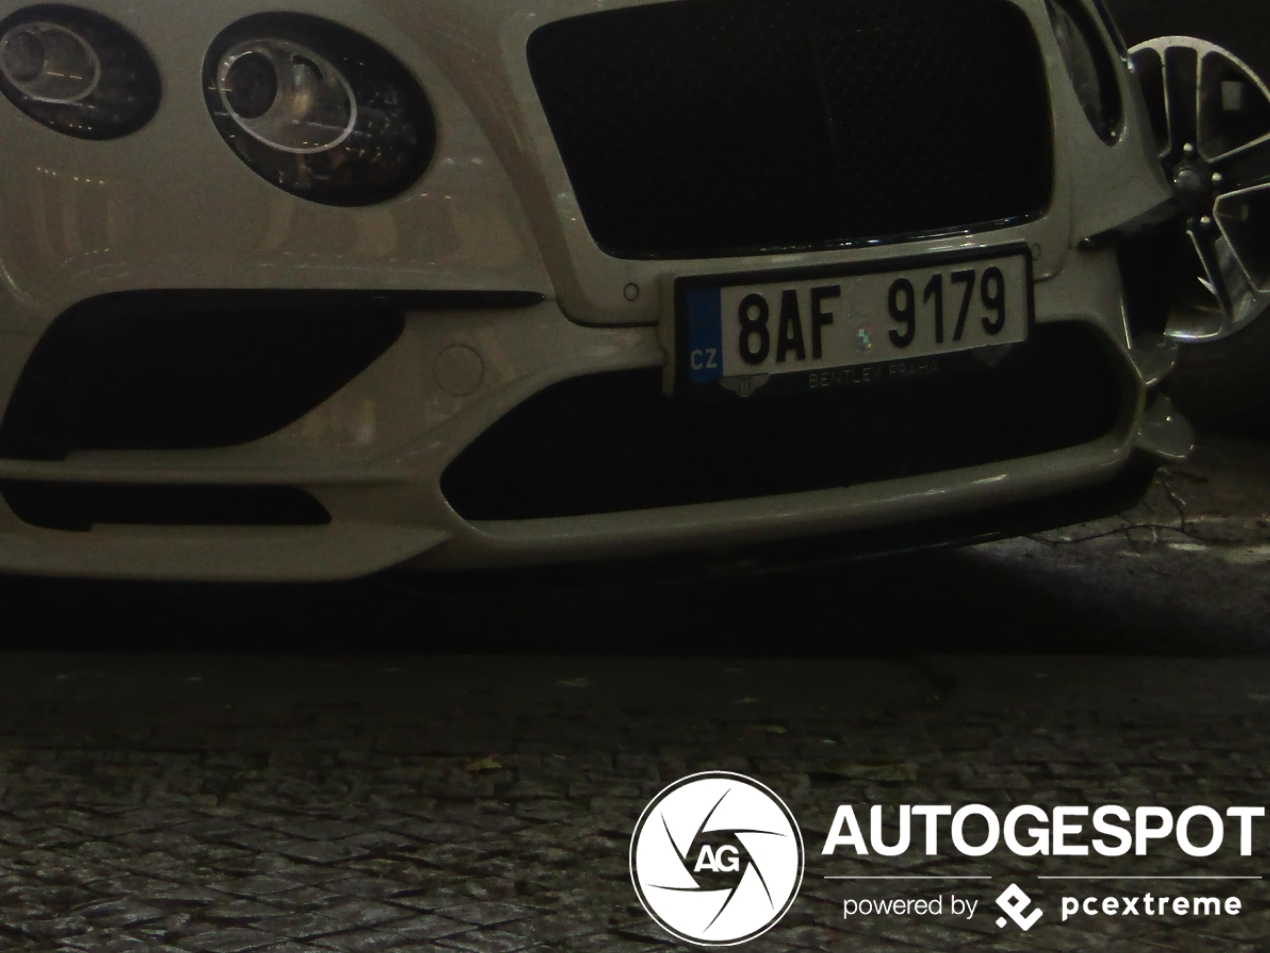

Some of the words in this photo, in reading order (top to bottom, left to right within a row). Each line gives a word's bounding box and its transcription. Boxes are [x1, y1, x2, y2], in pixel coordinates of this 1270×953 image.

[738, 285, 842, 365] 8AF
[887, 266, 1006, 348] 9179
[690, 348, 718, 370] CZ
[808, 367, 882, 389] BENTLEY
[888, 360, 940, 379] PRAHA
